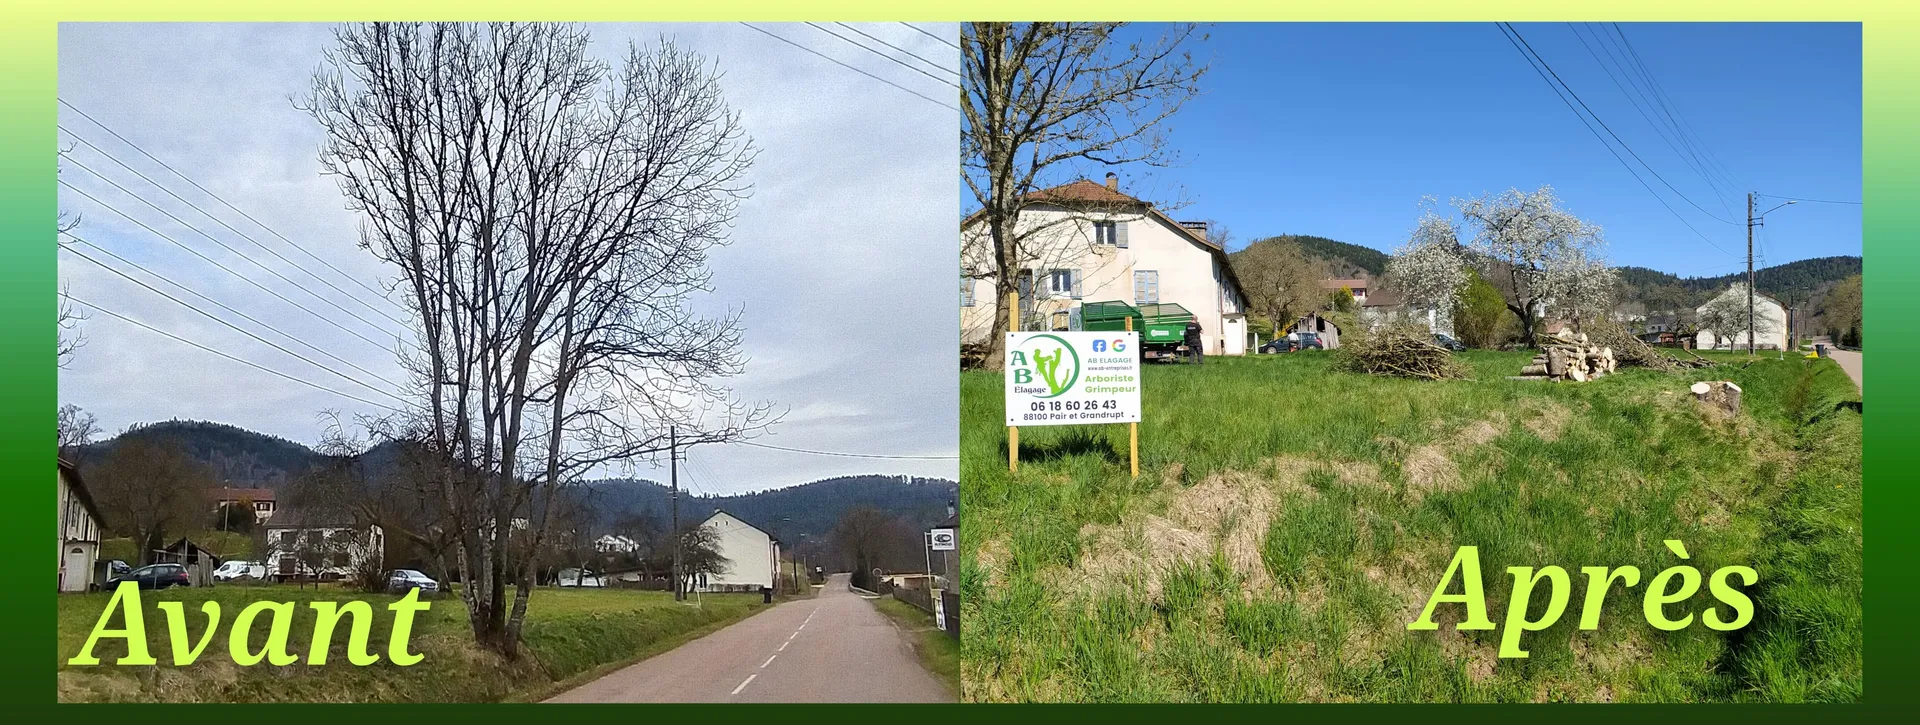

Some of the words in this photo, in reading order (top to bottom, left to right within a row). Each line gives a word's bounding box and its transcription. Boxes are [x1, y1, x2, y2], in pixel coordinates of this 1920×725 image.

[1011, 351, 1028, 365] A
[1013, 368, 1033, 384] B
[1085, 374, 1134, 382] Arboriste
[1085, 385, 1136, 394] Grimpeur
[1030, 401, 1045, 411] 06
[1049, 401, 1061, 411] 18
[1065, 401, 1080, 411] 60
[1084, 400, 1098, 410] 26
[1102, 400, 1117, 409] 43
[1023, 413, 1048, 421] 88100
[1080, 411, 1124, 420] Grandrupt
